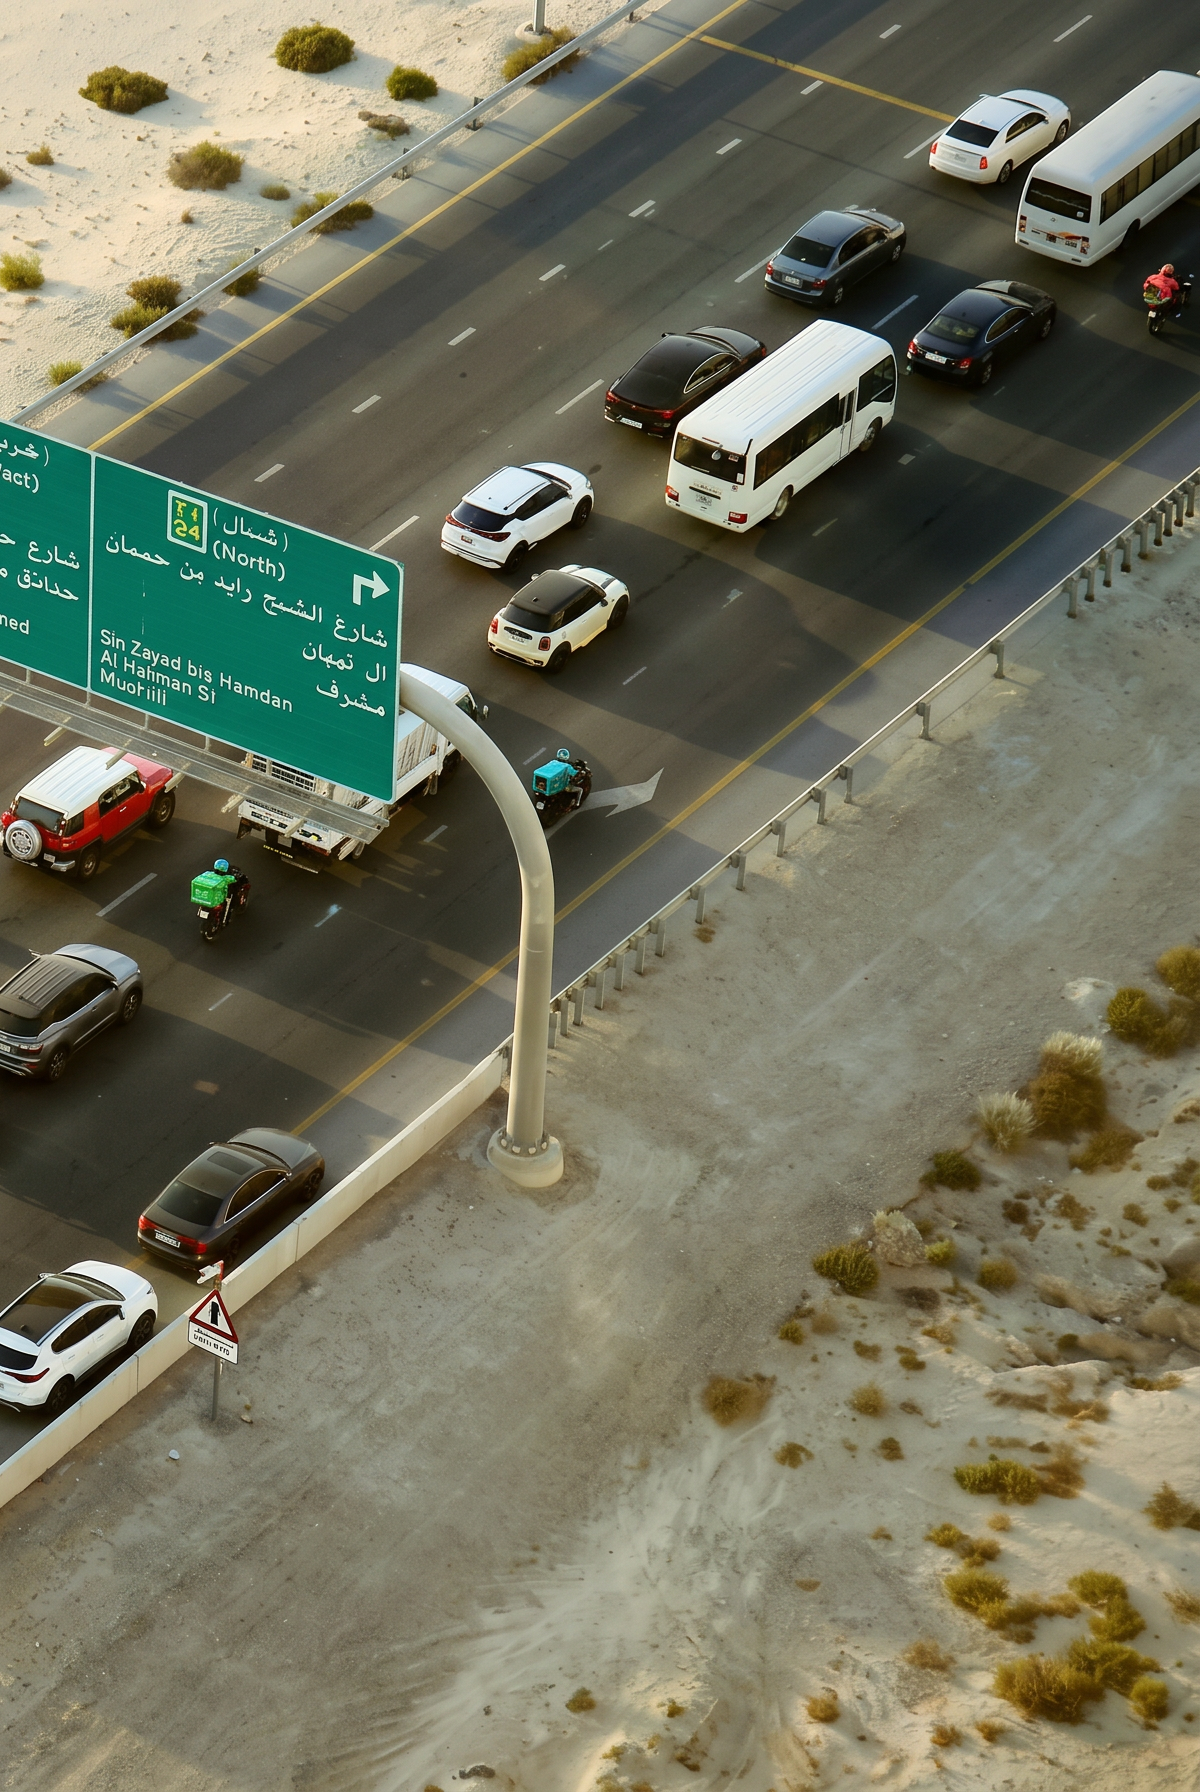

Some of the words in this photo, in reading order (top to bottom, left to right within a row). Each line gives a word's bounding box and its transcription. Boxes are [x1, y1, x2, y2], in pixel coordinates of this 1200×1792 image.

[212, 539, 286, 582] (North)
[100, 649, 118, 669] Al
[100, 628, 126, 652] Sin
[130, 639, 181, 671] Zayad
[187, 659, 213, 684] bis
[220, 672, 293, 713] Hamdan
